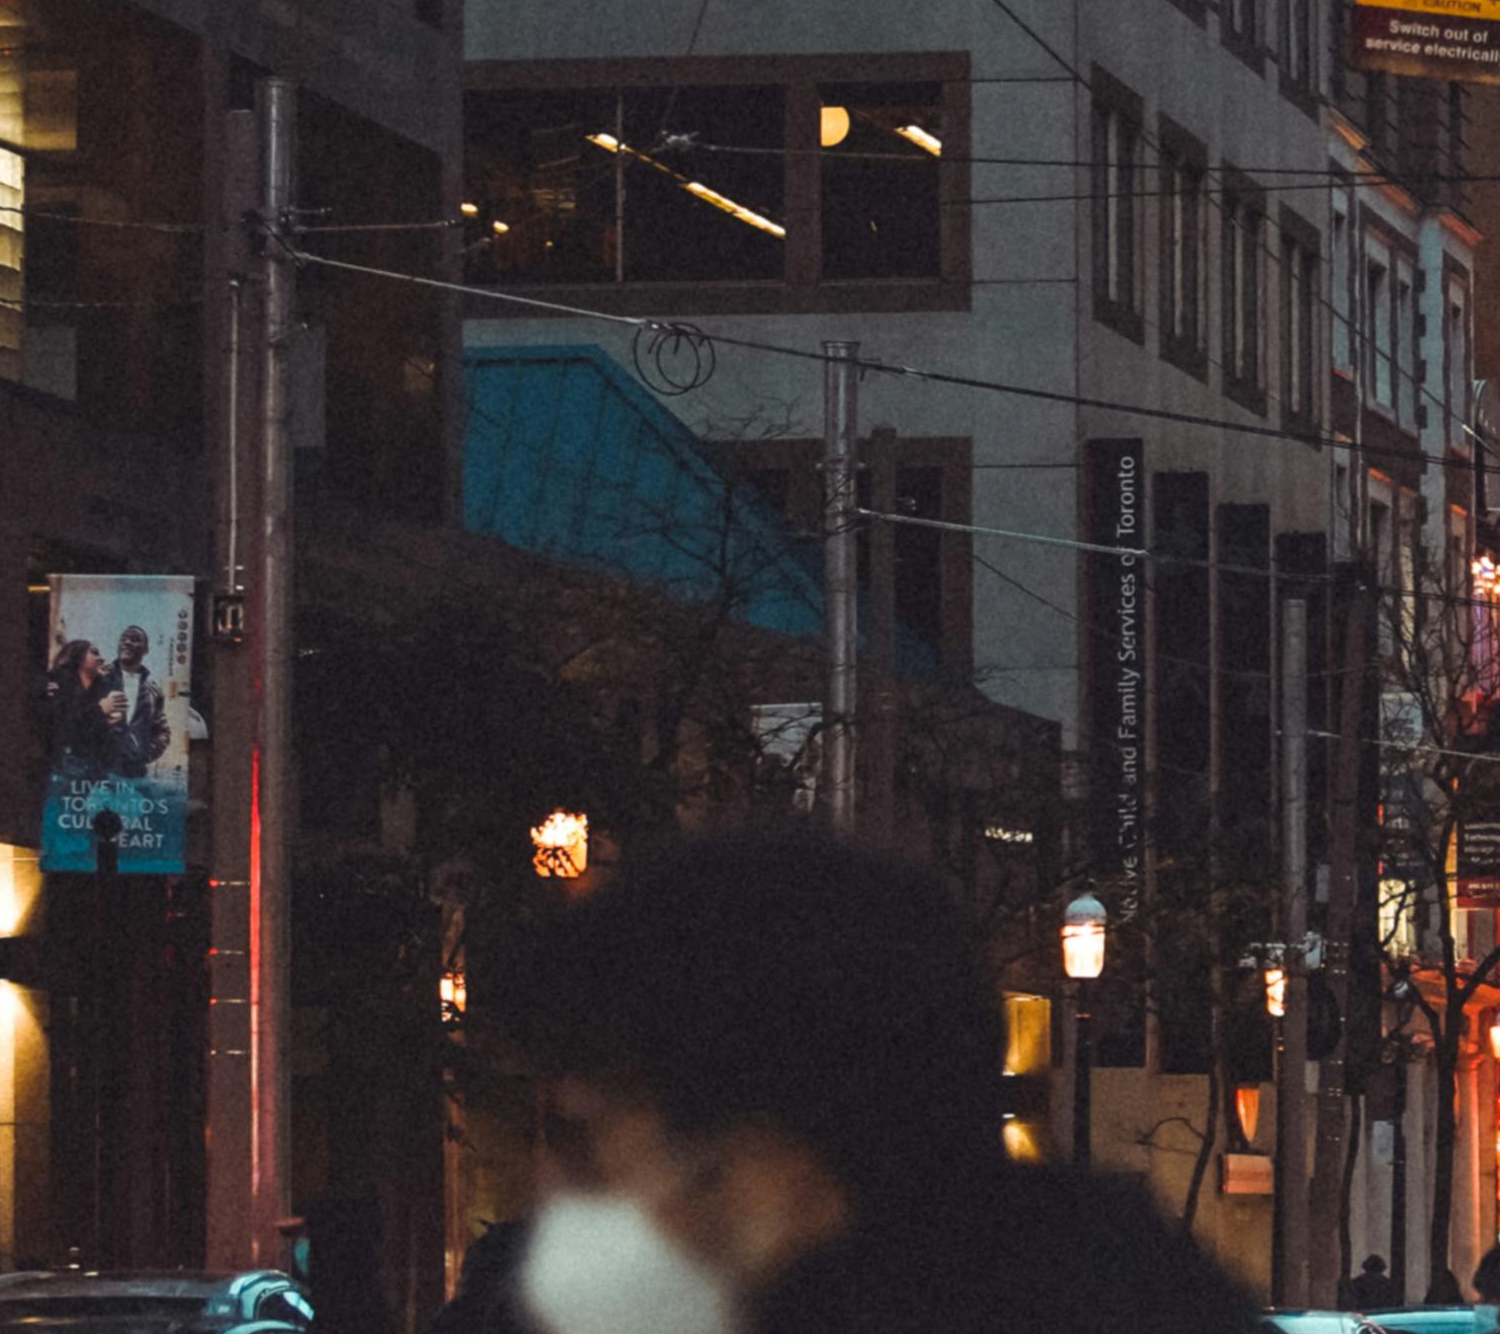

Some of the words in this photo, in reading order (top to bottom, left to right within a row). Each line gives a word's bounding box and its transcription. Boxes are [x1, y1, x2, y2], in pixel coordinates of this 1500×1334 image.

[1389, 19, 1440, 38] Switch
[1443, 27, 1470, 42] out
[1472, 30, 1489, 44] of
[1365, 37, 1421, 54] service
[1115, 455, 1136, 539] Toronto
[1117, 573, 1137, 662] Services
[1118, 668, 1141, 740] Family
[70, 779, 111, 795] LIVE
[116, 781, 135, 796] IN
[57, 814, 154, 831] CULRAL
[111, 833, 165, 849] EART
